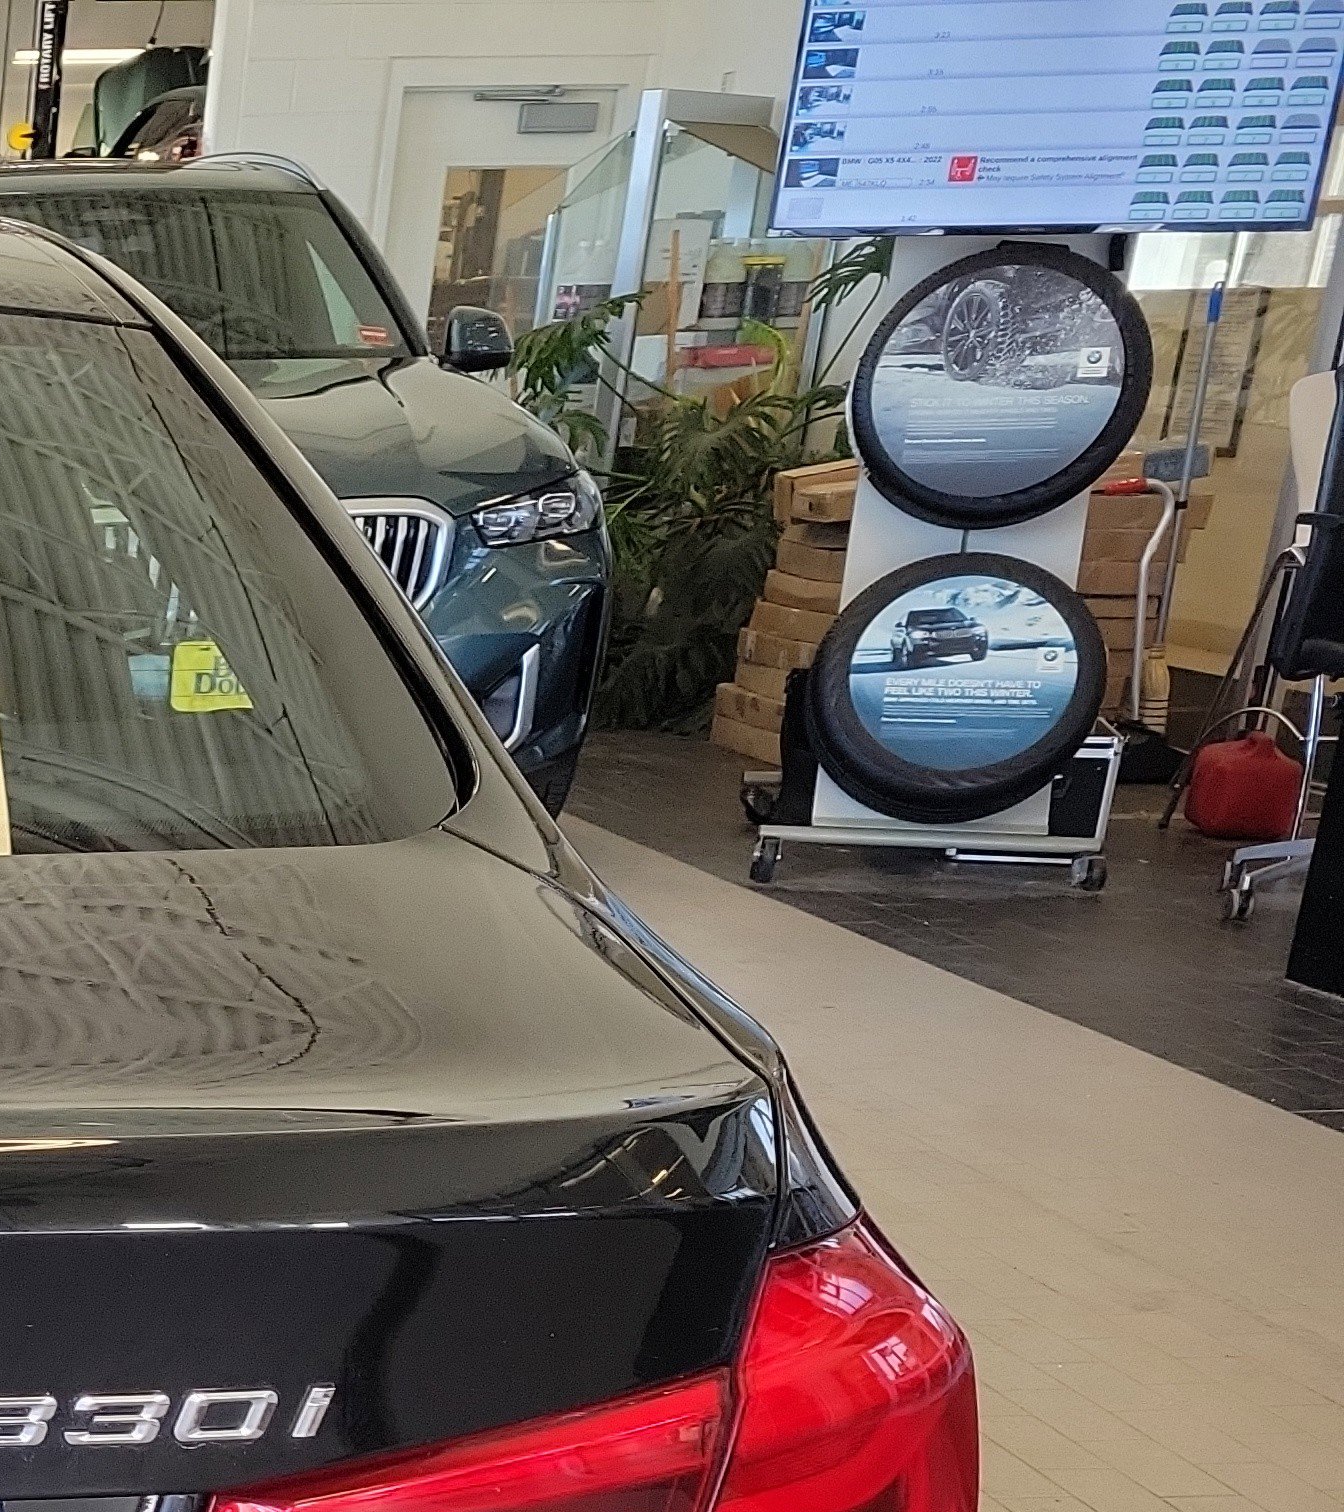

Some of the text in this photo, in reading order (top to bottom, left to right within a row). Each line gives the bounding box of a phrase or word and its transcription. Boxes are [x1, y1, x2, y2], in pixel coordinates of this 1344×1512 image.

[39, 4, 56, 83] ROTARY LIFT
[980, 156, 1029, 164] Recommend
[1037, 154, 1097, 164] comprehensive
[1098, 154, 1138, 165] alignment
[886, 678, 919, 686] EVERY
[995, 680, 1026, 688] HAVE
[884, 686, 1033, 698] FEEL LIKE TWO THIS WINTER.
